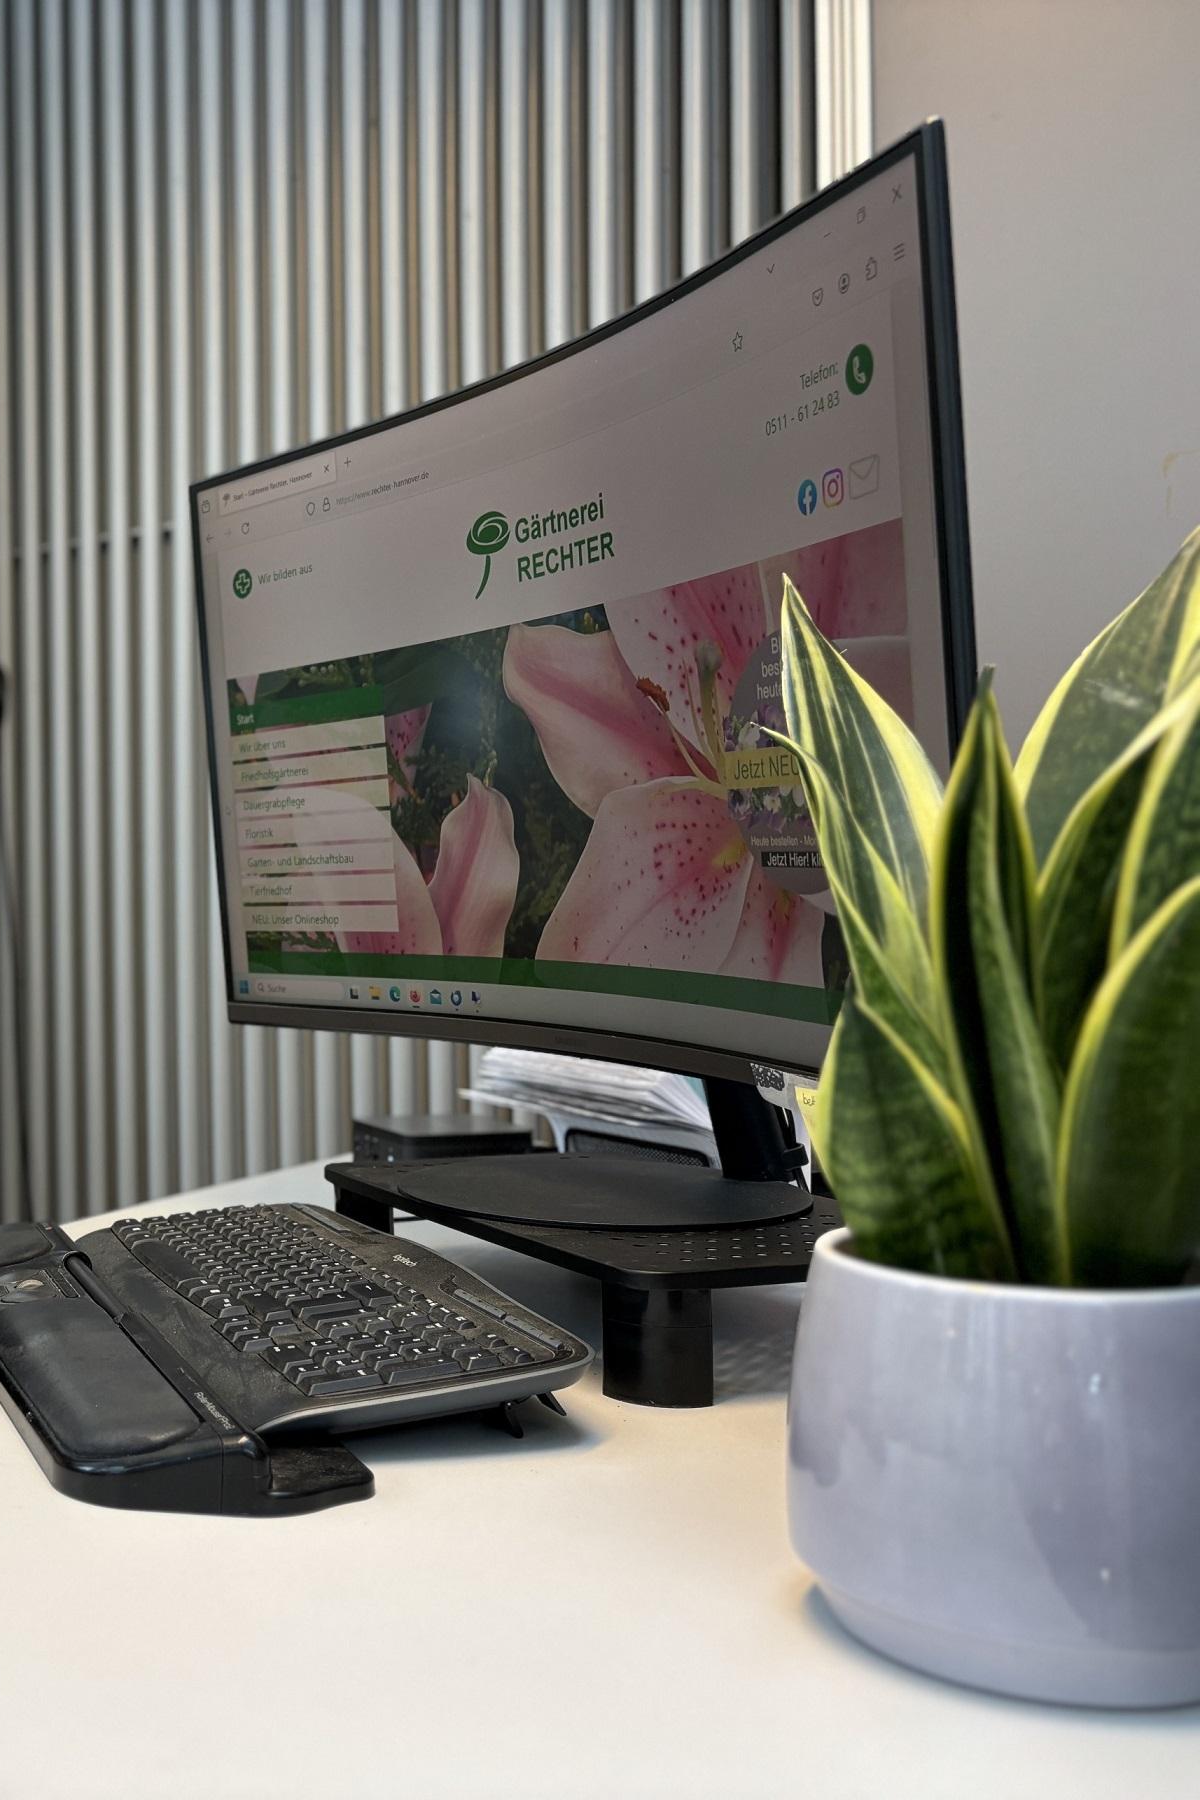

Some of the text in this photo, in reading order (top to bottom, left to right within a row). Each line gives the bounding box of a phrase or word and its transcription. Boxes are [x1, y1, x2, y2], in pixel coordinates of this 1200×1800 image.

[800, 362, 839, 390] Telefon:
[765, 413, 787, 436] 0511
[798, 404, 809, 422] 61
[812, 397, 825, 416] 24
[827, 390, 840, 409] 83
[515, 492, 604, 543] Gärtnerei
[517, 532, 615, 582] RECHTER
[258, 564, 313, 585] Wir bilden aus
[237, 714, 254, 725] Start
[239, 740, 286, 753] Wir über uns
[734, 759, 766, 780] Jetzt
[243, 796, 305, 812] Dauergrabpflege
[245, 828, 274, 839] Floristik
[750, 835, 769, 847] Heute
[771, 836, 799, 847] bestellen
[277, 857, 292, 866] und
[293, 853, 354, 866] Landschaftsbau
[767, 852, 787, 867] Jetzt
[789, 852, 809, 867] Hier!
[249, 885, 293, 897] Tierfriedhof
[272, 914, 293, 925] Unser
[295, 914, 340, 928] Onlineshop
[267, 984, 287, 993] Suche
